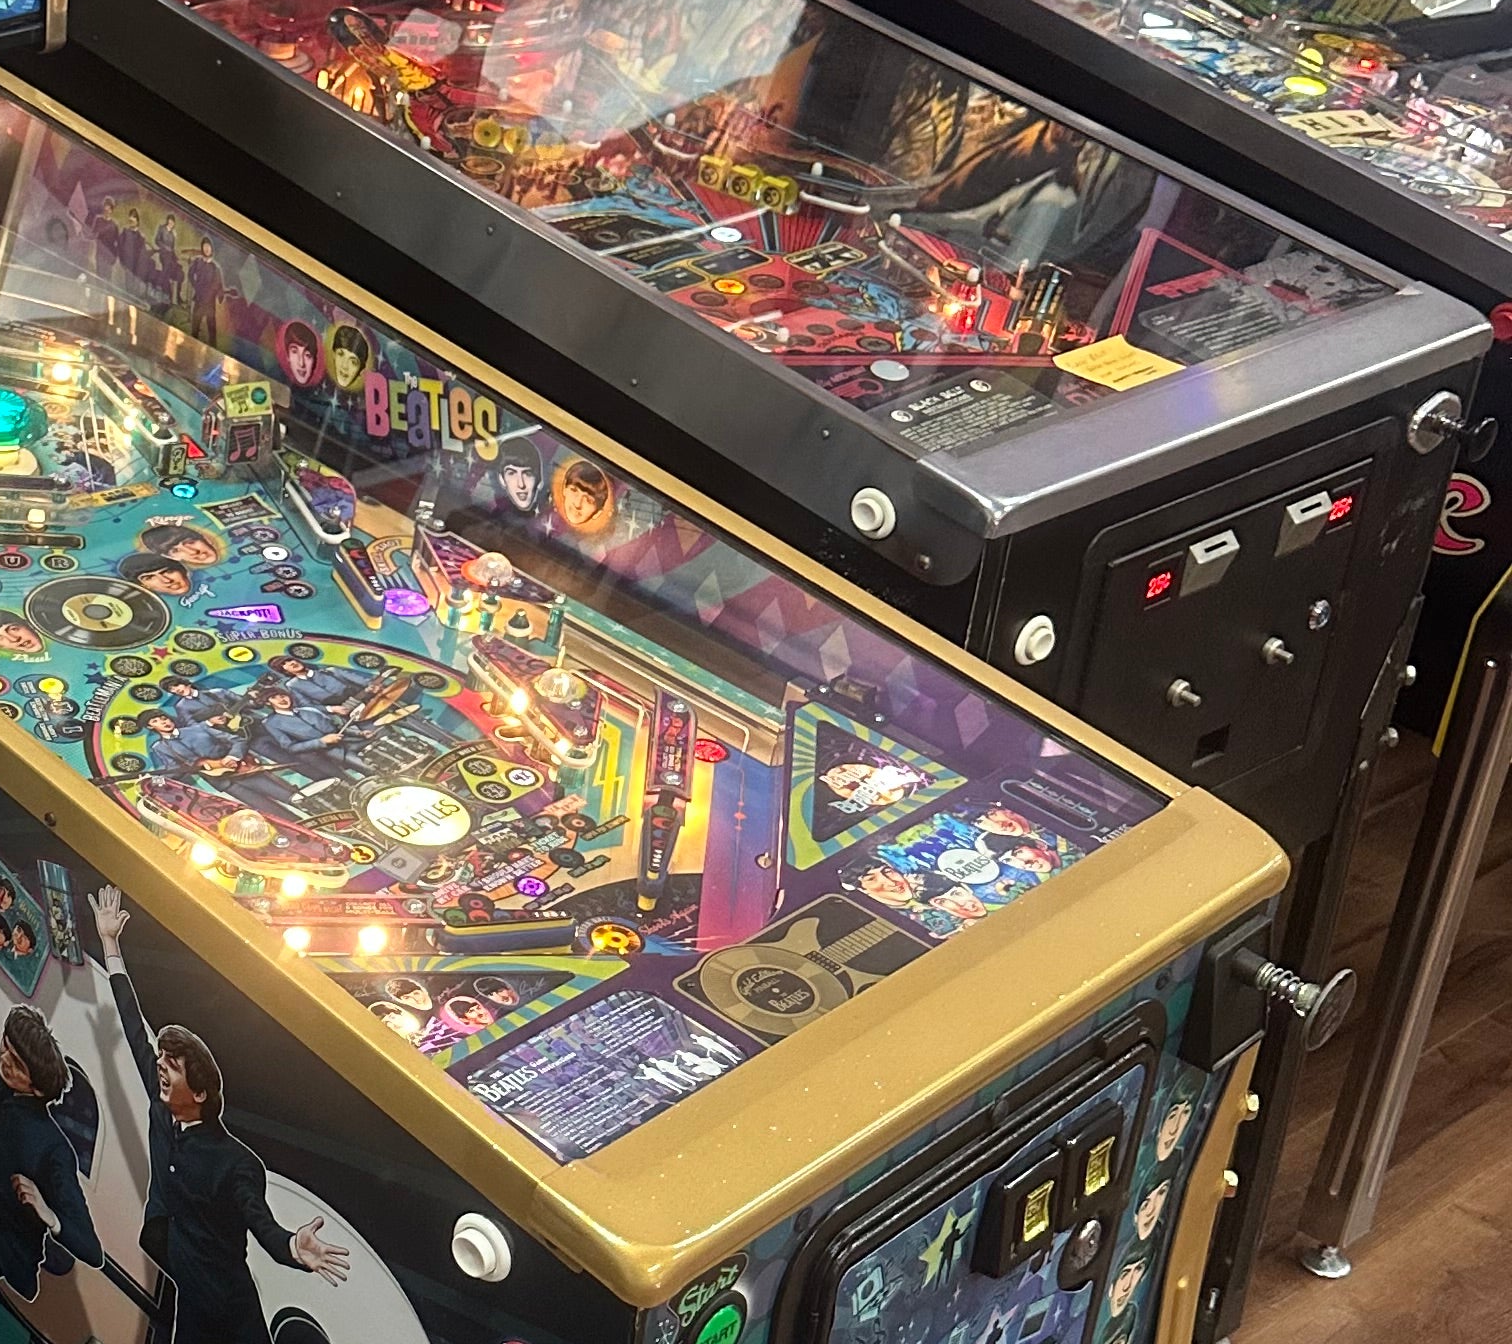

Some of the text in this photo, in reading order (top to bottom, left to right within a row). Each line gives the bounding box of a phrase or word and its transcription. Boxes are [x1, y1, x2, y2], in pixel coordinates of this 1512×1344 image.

[403, 370, 419, 388] The
[364, 370, 501, 462] BEATLES
[215, 628, 304, 644] SUPER BONUS
[82, 674, 130, 723] BEATLEMANIA
[376, 798, 461, 840] BEATLES
[943, 853, 994, 881] BEATLES
[767, 990, 812, 1013] BEATLES
[473, 1064, 540, 1103] BEATLES
[490, 1069, 505, 1081] THE
[676, 1264, 740, 1328] Start
